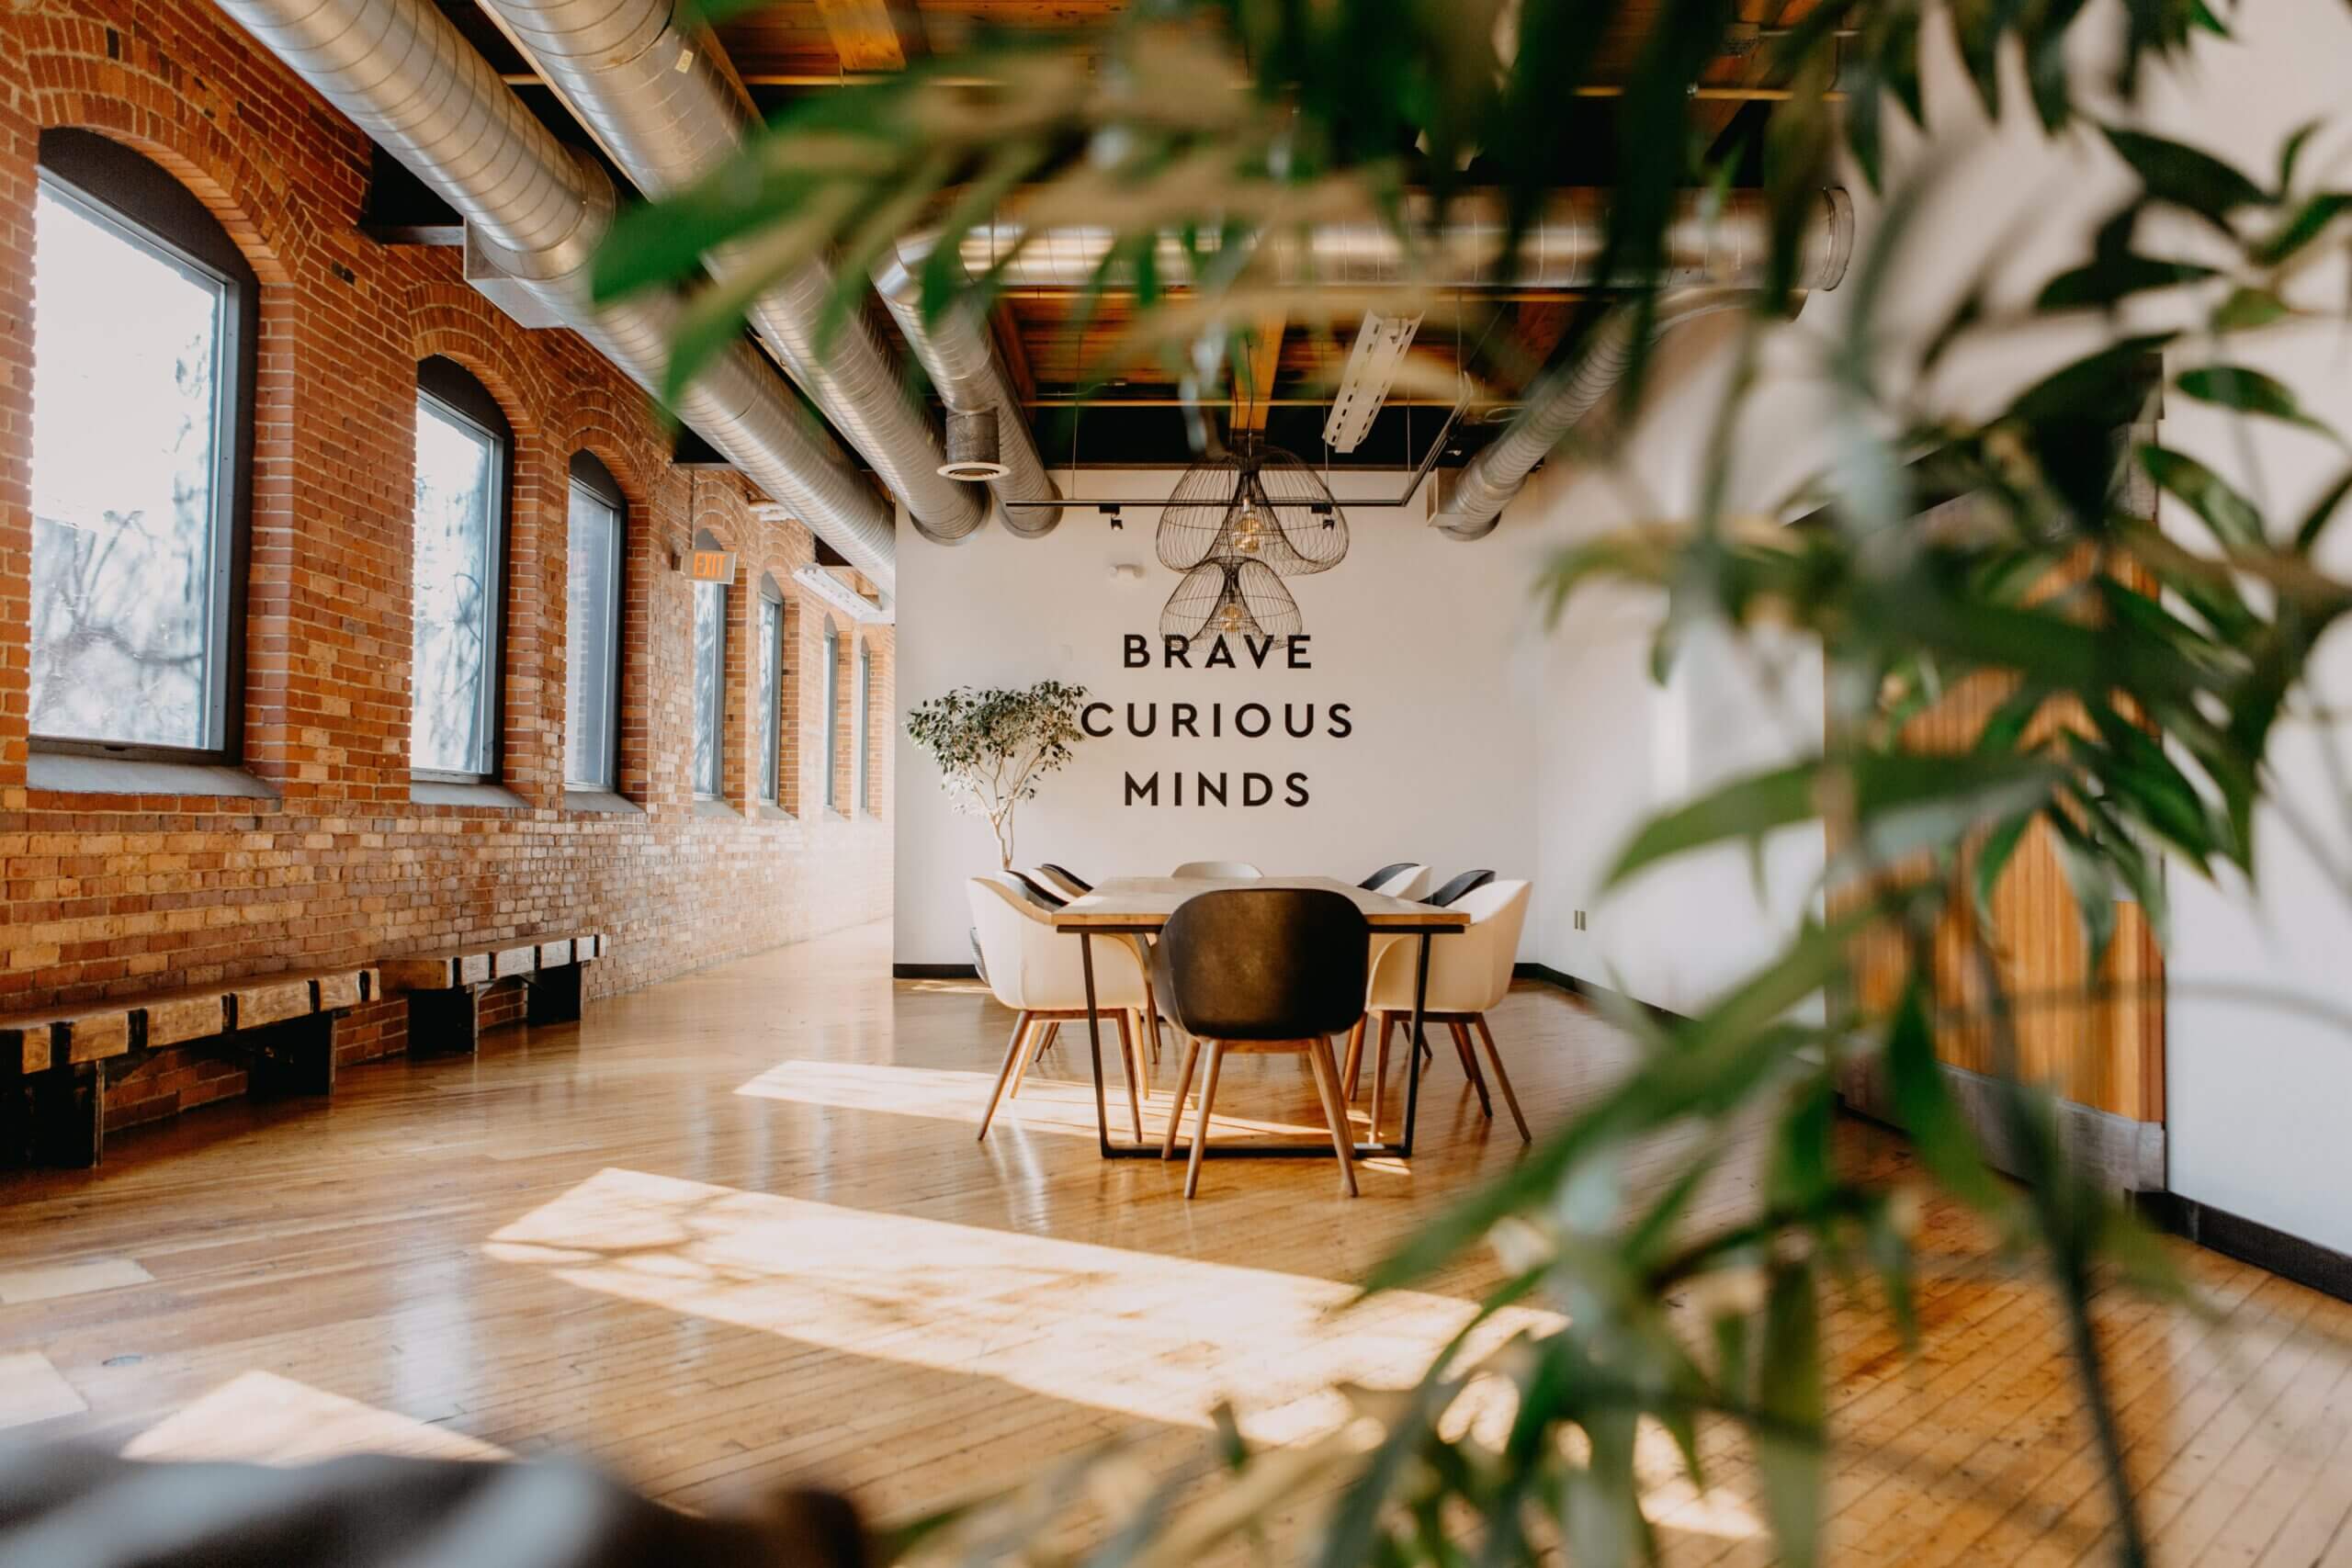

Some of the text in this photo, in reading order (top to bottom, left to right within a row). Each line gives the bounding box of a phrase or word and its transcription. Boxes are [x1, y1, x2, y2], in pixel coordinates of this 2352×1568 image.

[694, 553, 727, 577] EXIT
[1124, 634, 1312, 669] BRAVE
[1080, 702, 1352, 738] CURIOUS
[1125, 771, 1309, 807] MINDS
